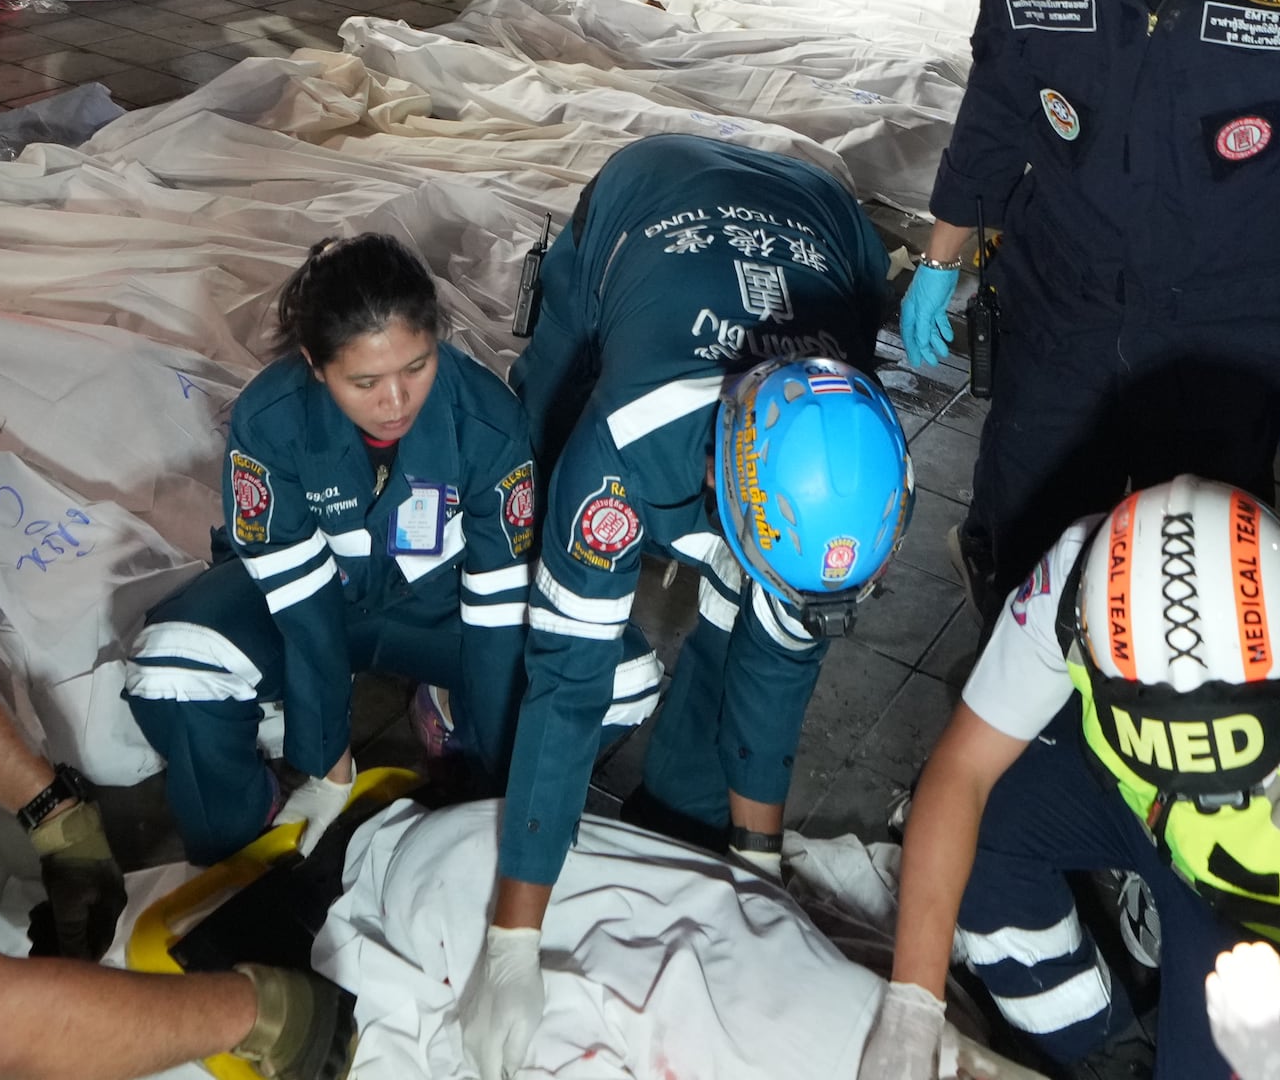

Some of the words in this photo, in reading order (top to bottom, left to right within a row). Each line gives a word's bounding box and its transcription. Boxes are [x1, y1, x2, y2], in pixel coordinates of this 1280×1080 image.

[644, 208, 712, 239] TUNG
[716, 205, 782, 226] TECK
[1234, 495, 1261, 548] TEAM
[1108, 592, 1130, 662] TEAM
[1237, 554, 1267, 664] MEDICAL
[1111, 705, 1265, 774] MED
